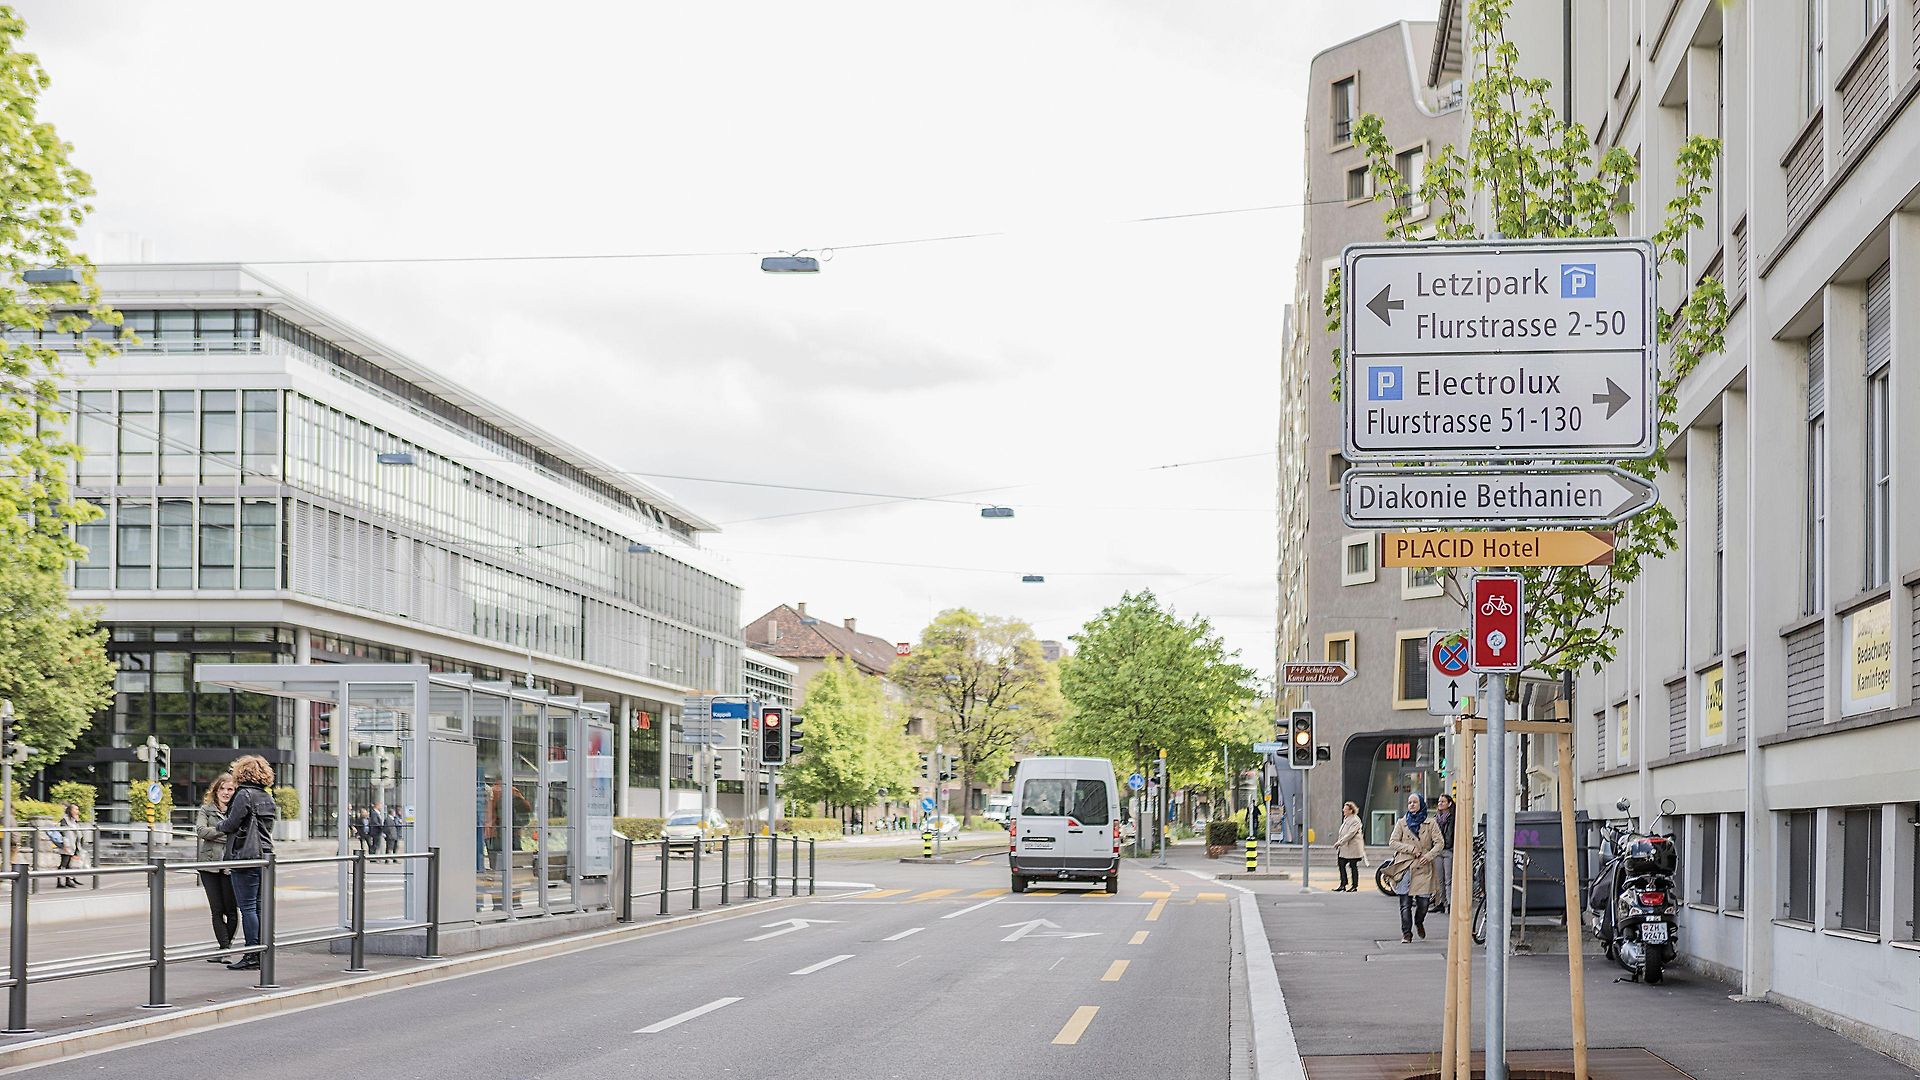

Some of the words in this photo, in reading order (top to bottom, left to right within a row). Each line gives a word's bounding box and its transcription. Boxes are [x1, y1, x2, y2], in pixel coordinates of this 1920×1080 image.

[1417, 268, 1549, 303] Letzipark
[1417, 312, 1557, 340] Flurstrasse
[1567, 310, 1626, 337] 2-50
[1417, 367, 1561, 397] Electrolux
[1367, 407, 1492, 435] Flurstrasse
[1500, 406, 1582, 433] 51-130
[1359, 484, 1467, 510] Diakonie
[1477, 482, 1602, 508] Bethanien
[1396, 538, 1474, 559] PLACID
[1482, 537, 1540, 558] Hotel
